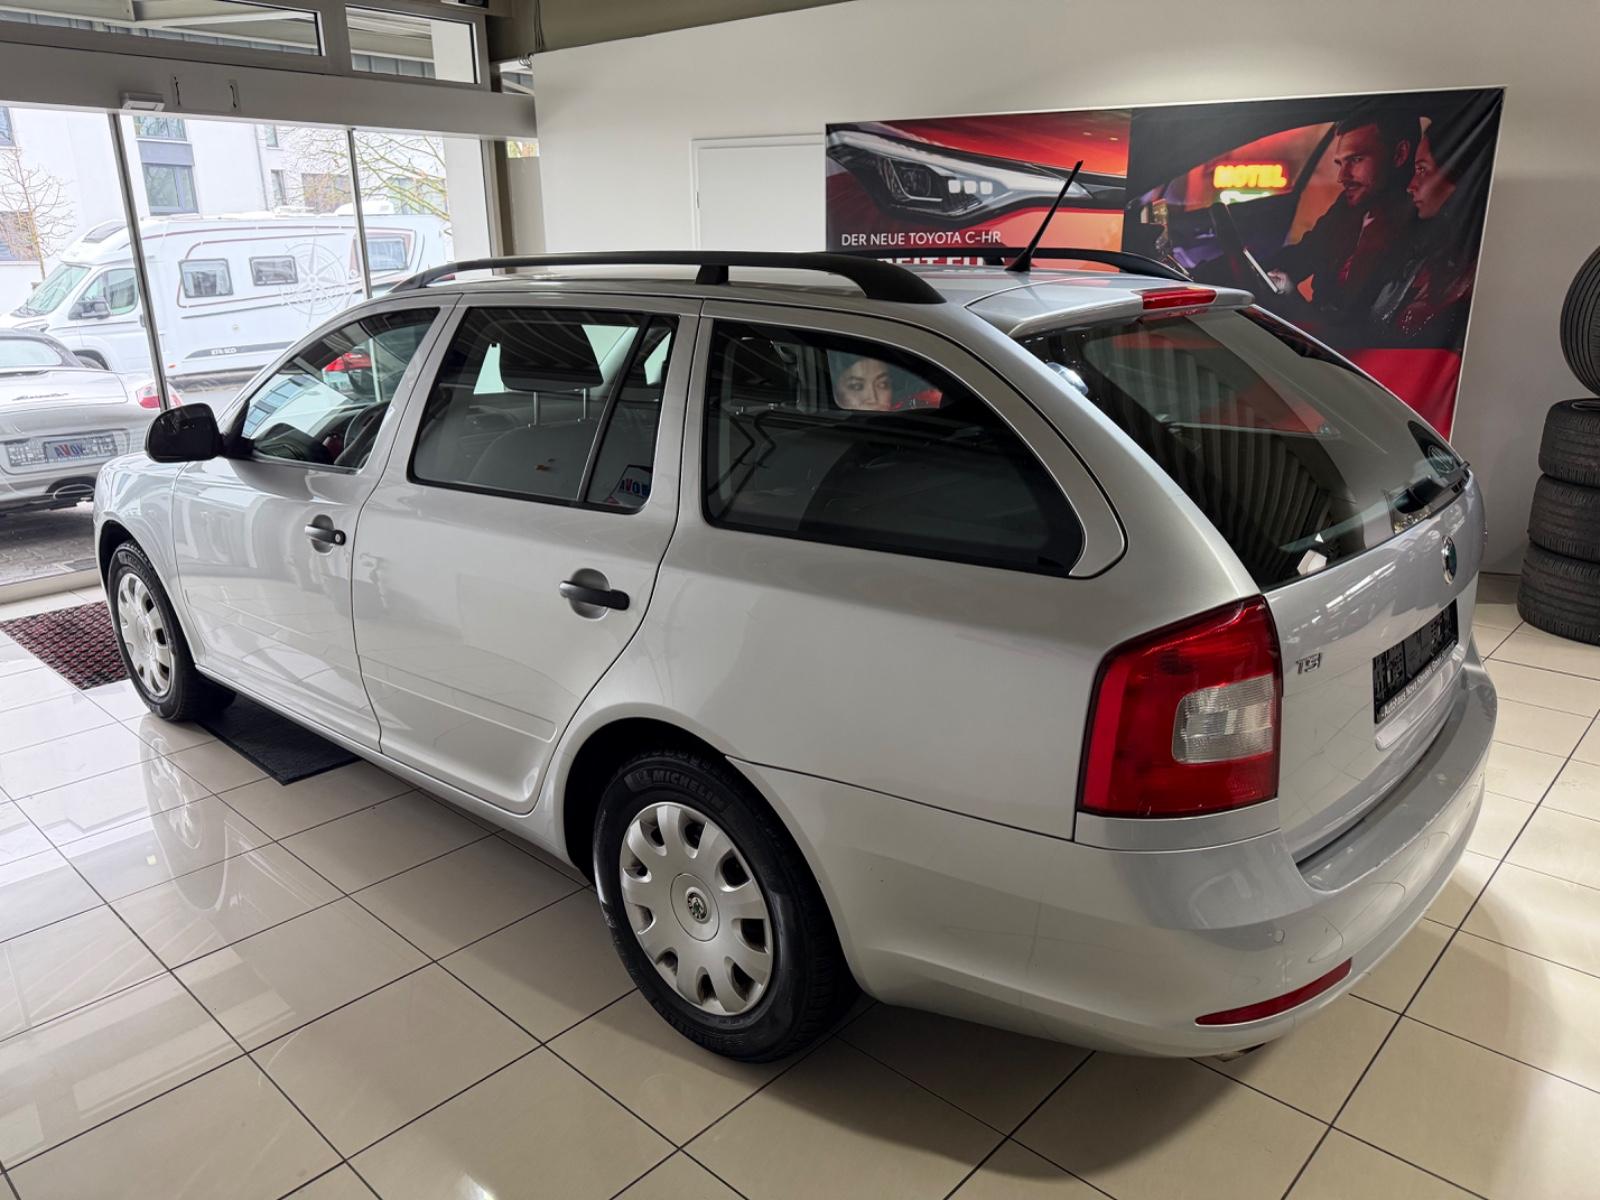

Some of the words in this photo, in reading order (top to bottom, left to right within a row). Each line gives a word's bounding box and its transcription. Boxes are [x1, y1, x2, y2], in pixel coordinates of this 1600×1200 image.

[841, 233, 867, 246] DER
[870, 232, 905, 245] NEUE
[909, 231, 961, 245] TOYOTA
[965, 230, 1001, 244] C-HR
[1295, 652, 1322, 675] TSI
